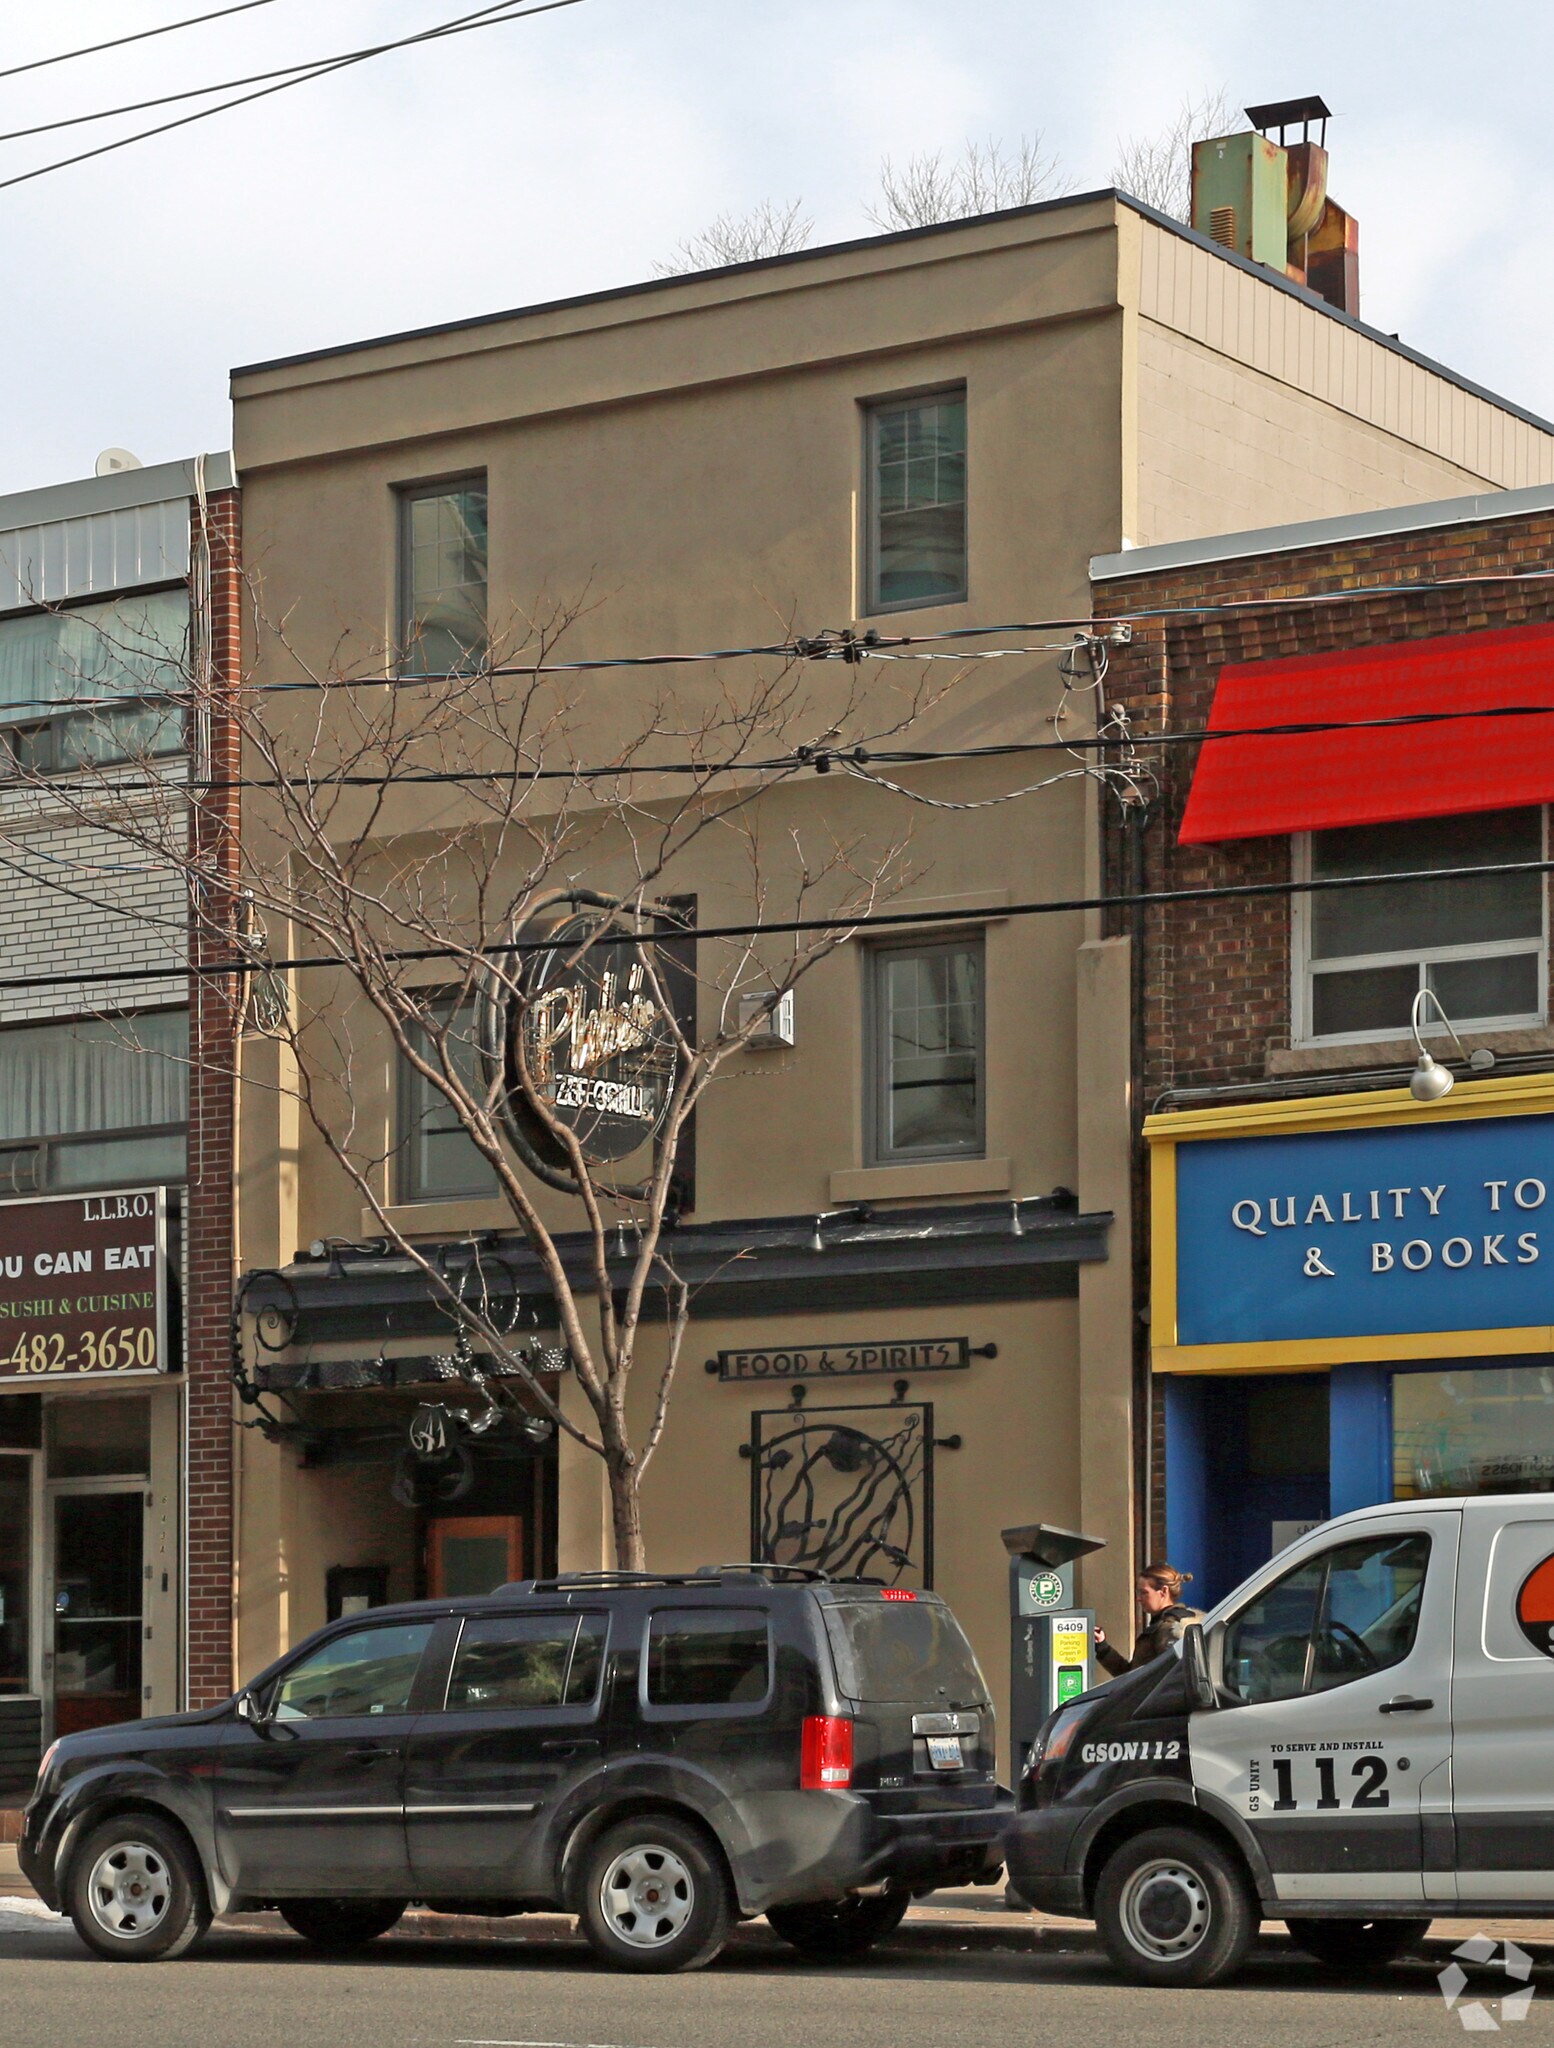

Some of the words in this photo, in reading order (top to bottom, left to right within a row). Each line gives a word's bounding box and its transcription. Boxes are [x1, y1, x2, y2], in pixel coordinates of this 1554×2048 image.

[83, 1194, 154, 1222] L.L.B.O.
[1231, 1184, 1446, 1236] QUALITY
[1483, 1178, 1547, 1211] TO
[34, 1249, 92, 1277] CAN
[104, 1244, 155, 1271] EAT
[1302, 1246, 1336, 1277] &
[1371, 1232, 1540, 1273] BOOKS
[0, 1298, 54, 1319] SUSHI
[59, 1298, 72, 1315] &
[76, 1291, 154, 1313] CUISINE
[735, 1353, 809, 1377] FOOD
[818, 1350, 836, 1373] &
[846, 1344, 950, 1370] SPIRITS
[1057, 1622, 1083, 1632] 6409
[1081, 1740, 1180, 1764] GSON112
[1270, 1744, 1284, 1752] TO
[1286, 1743, 1316, 1752] SERVE
[1318, 1742, 1340, 1751] AND
[1341, 1740, 1384, 1750] INSTALL
[1249, 1759, 1260, 1791] UNIT
[1272, 1755, 1390, 1811] 112
[1249, 1792, 1260, 1812] GS
